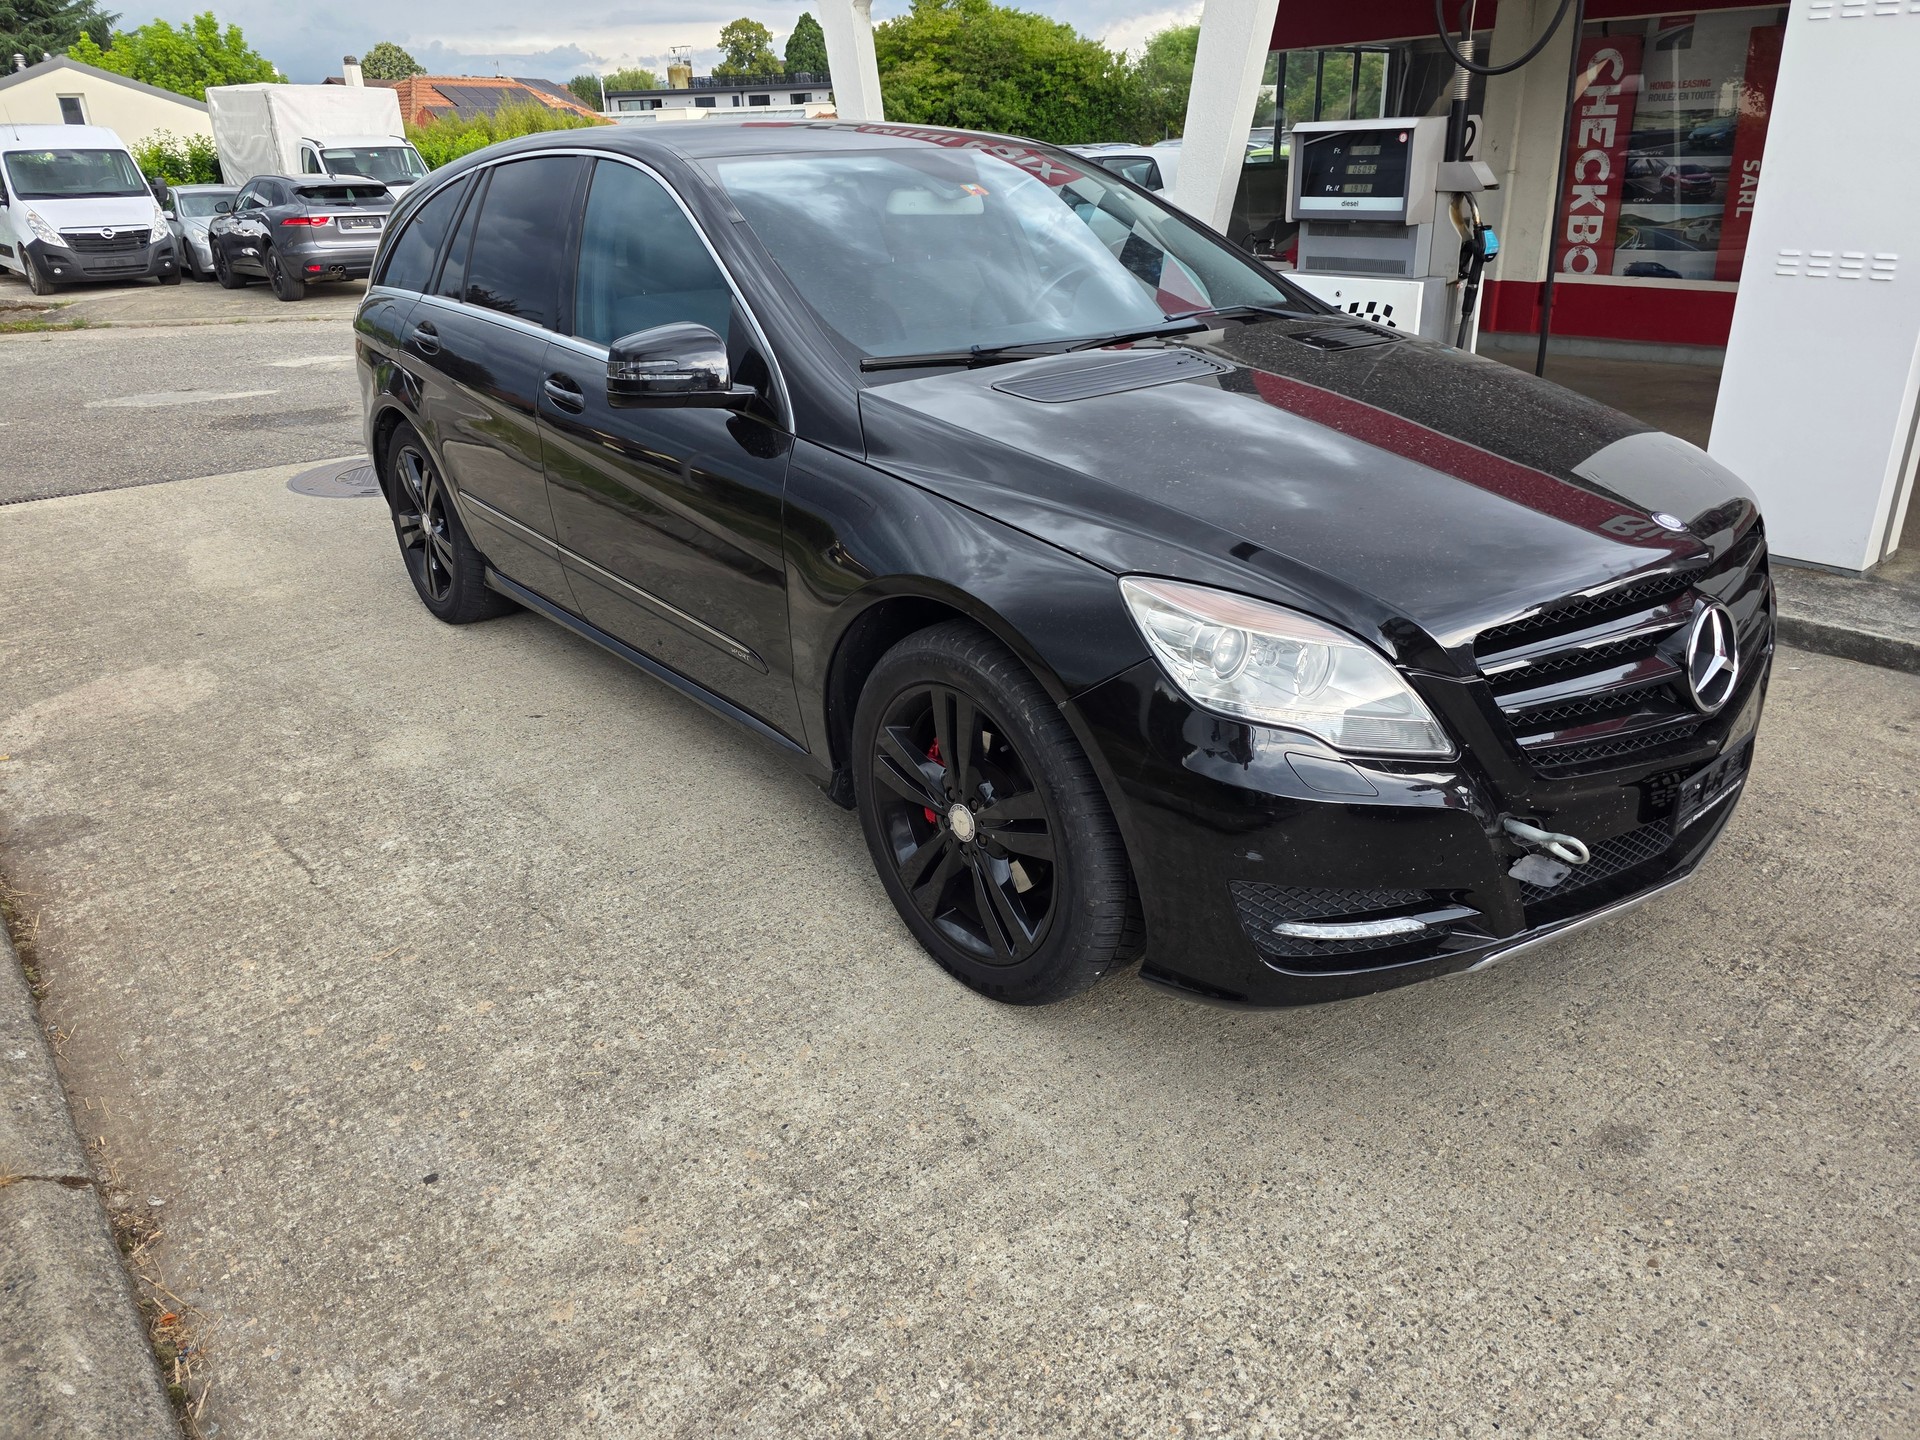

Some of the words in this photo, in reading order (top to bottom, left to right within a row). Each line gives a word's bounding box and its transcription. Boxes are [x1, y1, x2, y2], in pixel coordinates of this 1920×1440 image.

[1678, 79, 1711, 89] LEASING
[1679, 92, 1688, 100] EN
[1691, 90, 1716, 100] TOUTE
[1736, 160, 1760, 218] SARL
[1341, 199, 1359, 207] diesel
